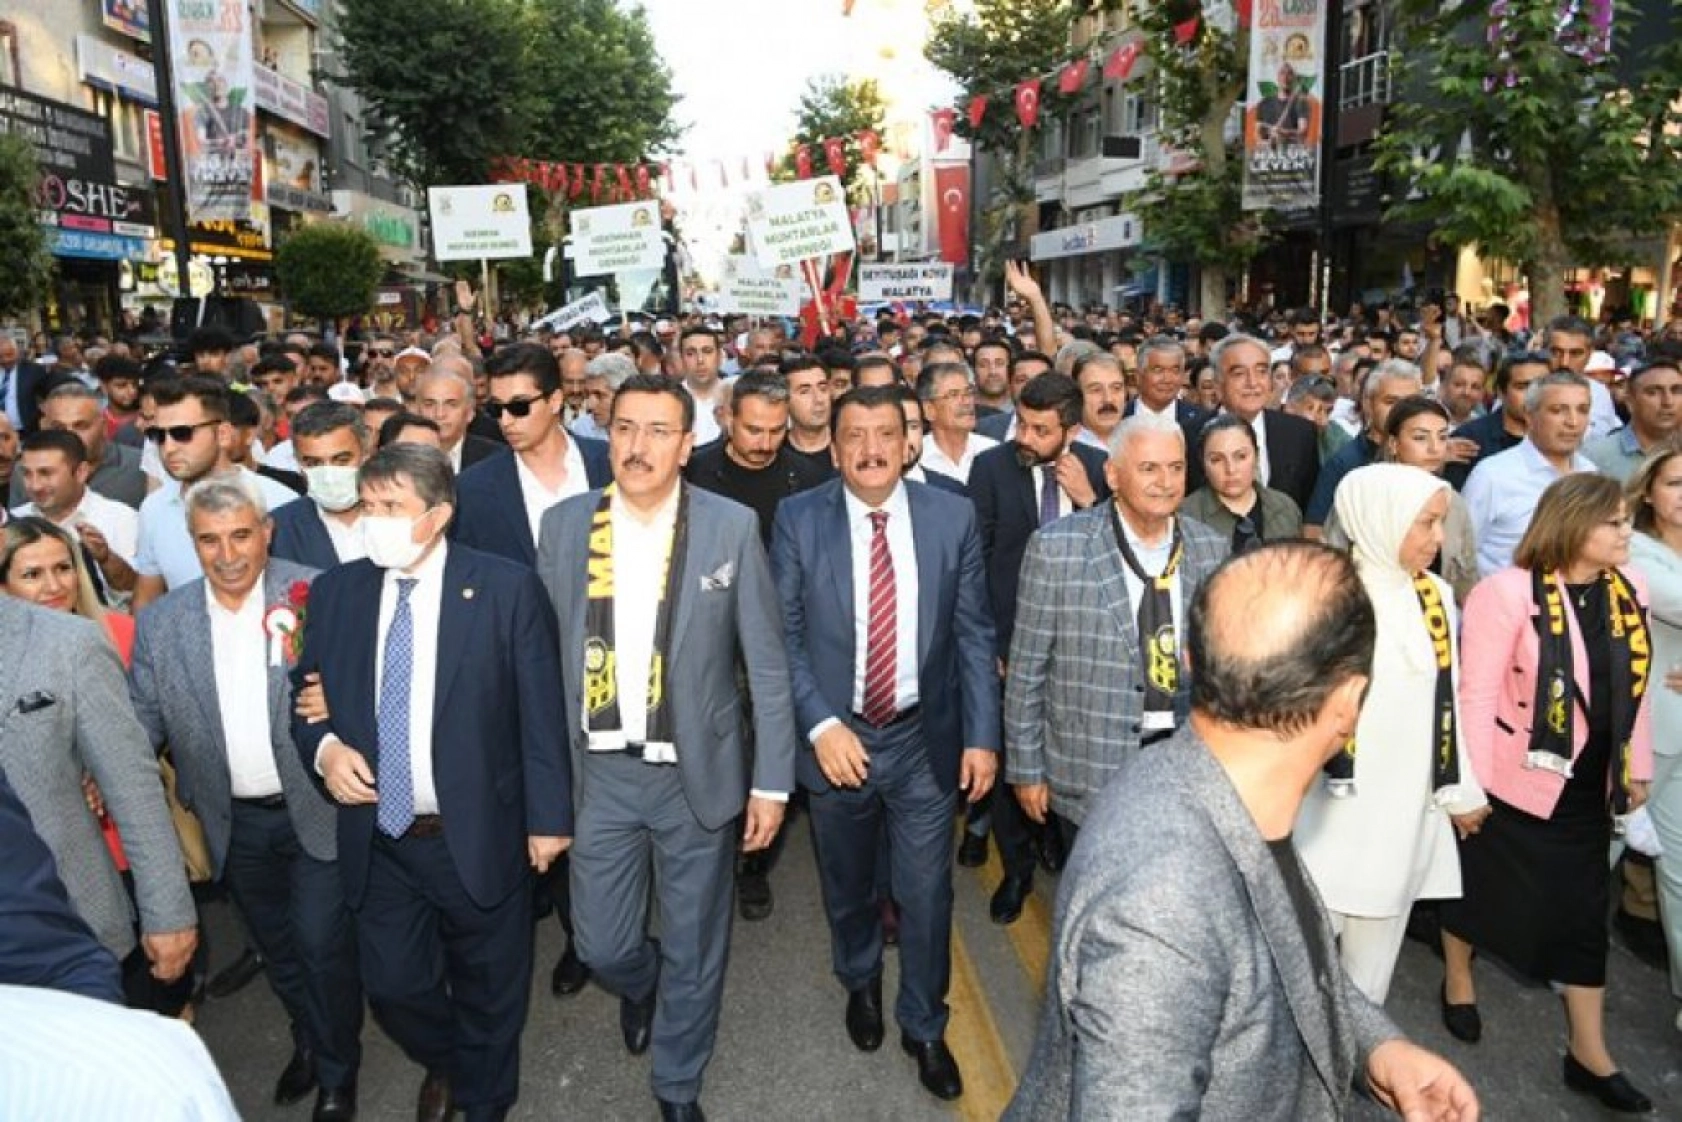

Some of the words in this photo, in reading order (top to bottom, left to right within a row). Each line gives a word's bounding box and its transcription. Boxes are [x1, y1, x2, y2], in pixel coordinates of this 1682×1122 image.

[769, 208, 826, 226] MALATYA
[764, 221, 838, 244] MUHTARLAR
[881, 285, 934, 297] MALATYA
